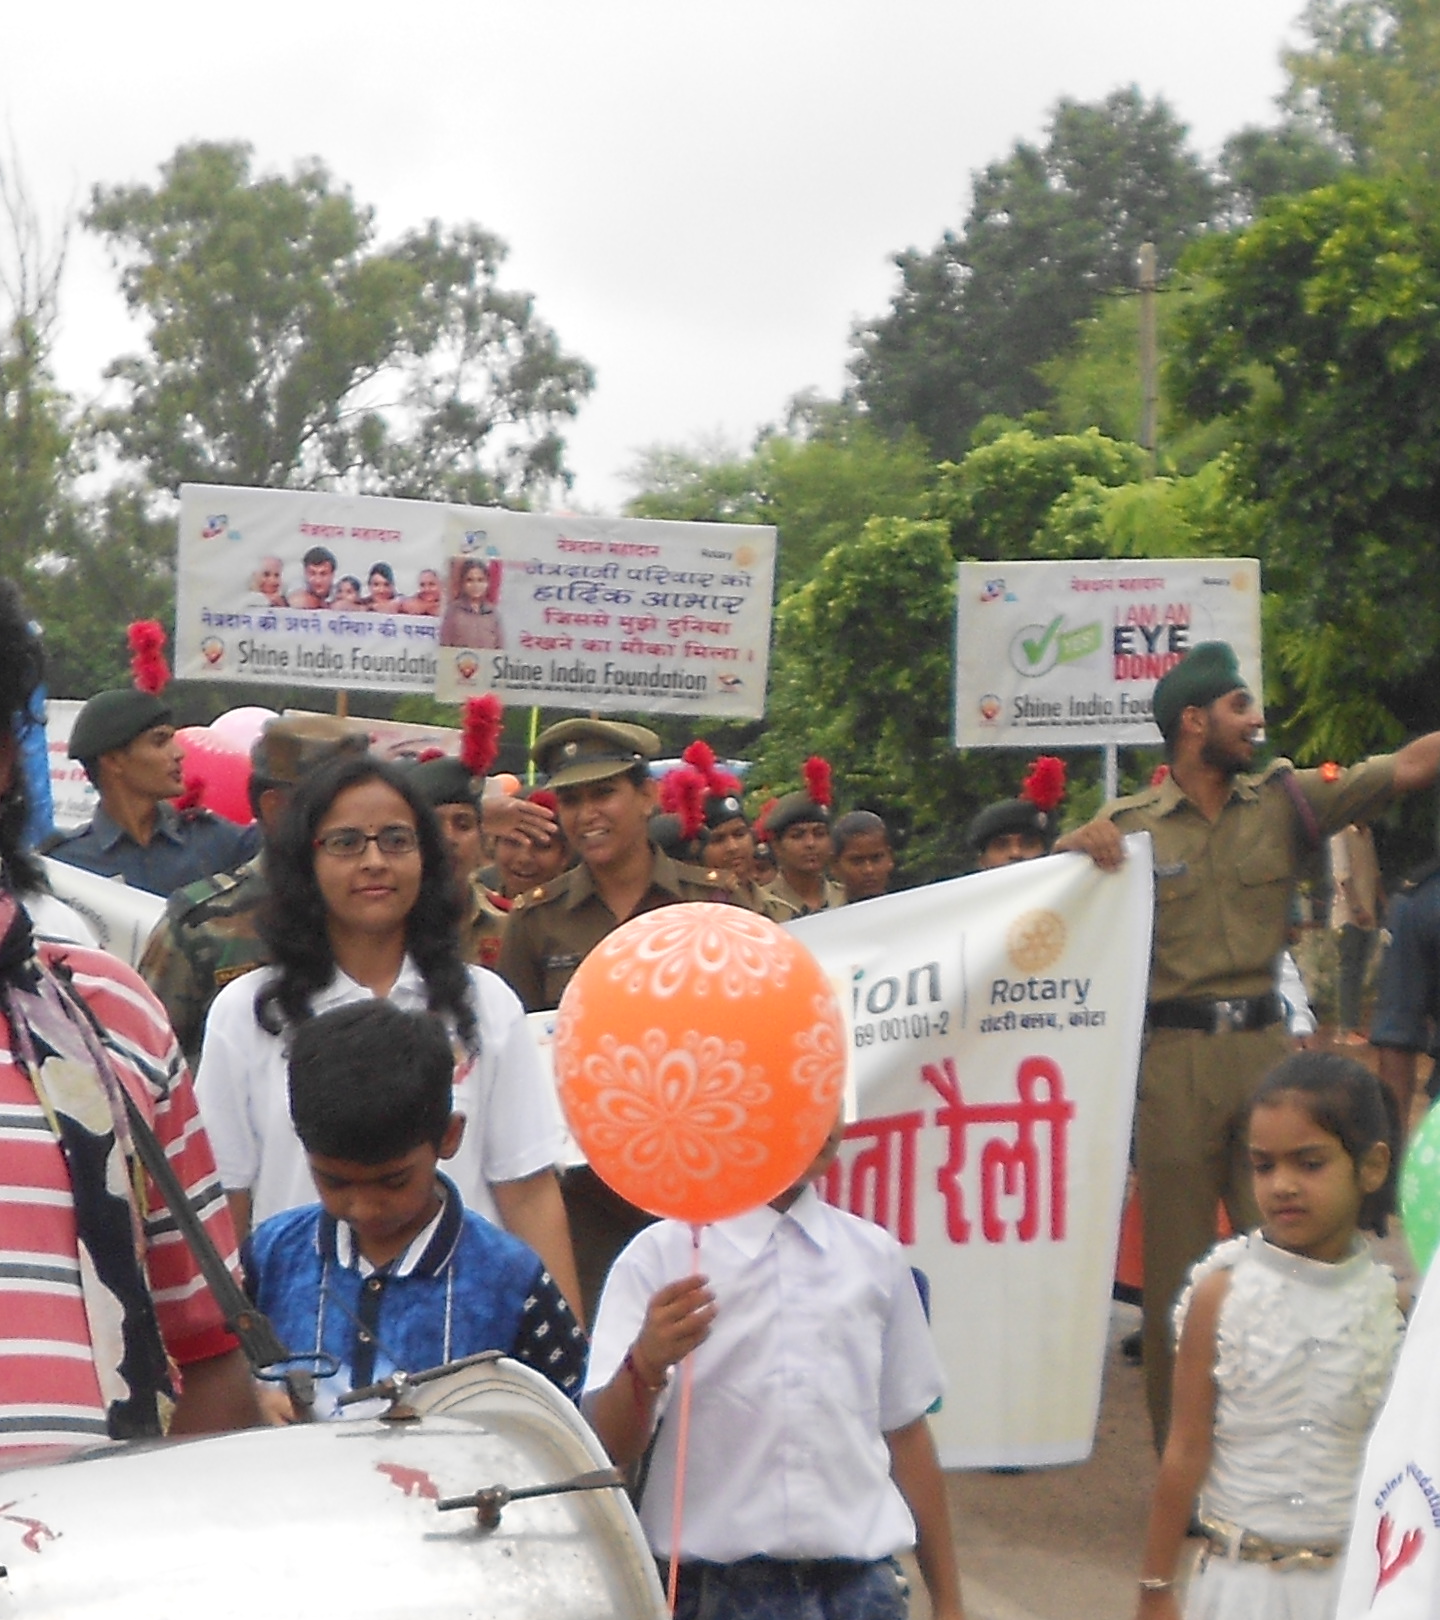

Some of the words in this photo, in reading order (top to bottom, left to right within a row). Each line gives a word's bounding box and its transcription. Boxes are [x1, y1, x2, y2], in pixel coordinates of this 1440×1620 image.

[627, 564, 715, 586] परिवार
[720, 571, 752, 588] को
[533, 580, 632, 605] हार्दिक
[642, 590, 745, 614] आभार
[201, 607, 252, 631] नेत्रदान
[259, 611, 277, 632] को
[285, 613, 320, 633] अपने
[328, 615, 373, 637] परिवार
[378, 616, 398, 638] की
[543, 607, 610, 628] जिससे
[667, 615, 733, 637] दुनिया
[238, 639, 289, 667] Shine
[297, 644, 343, 671] India
[520, 630, 573, 651] देखने
[582, 639, 612, 652] का
[620, 637, 677, 657] मौका
[684, 641, 740, 661] मिला
[1113, 625, 1190, 655] EYE
[492, 656, 543, 680] Shine
[550, 659, 596, 684] India
[604, 663, 707, 691] Foundation
[1013, 694, 1062, 719] Shine
[1069, 691, 1112, 717] India
[1120, 692, 1154, 716] Fou
[851, 961, 942, 1019] ion
[991, 976, 1092, 1005] Rotary
[880, 1010, 950, 1042] 00101-2
[1069, 1006, 1107, 1028] कोटा
[921, 1054, 1077, 1244] रैली
